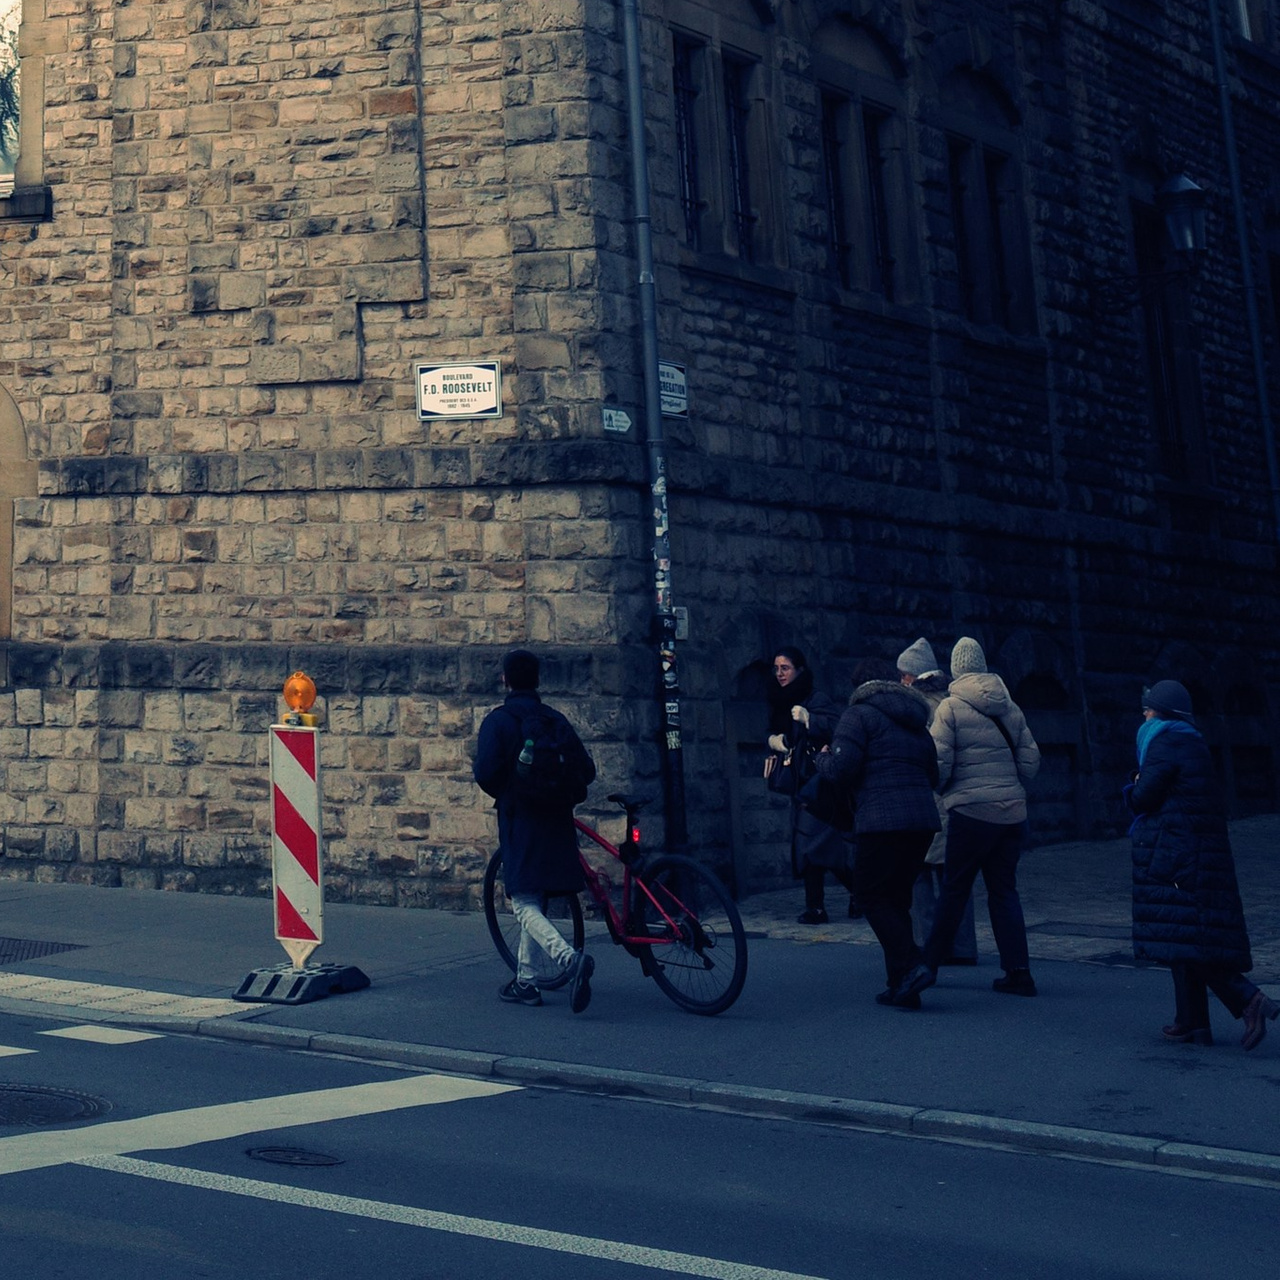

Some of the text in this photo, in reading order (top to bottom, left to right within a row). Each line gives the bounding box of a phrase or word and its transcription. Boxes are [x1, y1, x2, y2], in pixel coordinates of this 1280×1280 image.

[442, 373, 473, 381] BOULEVARD
[423, 382, 493, 395] F.D. ROOSEVELT
